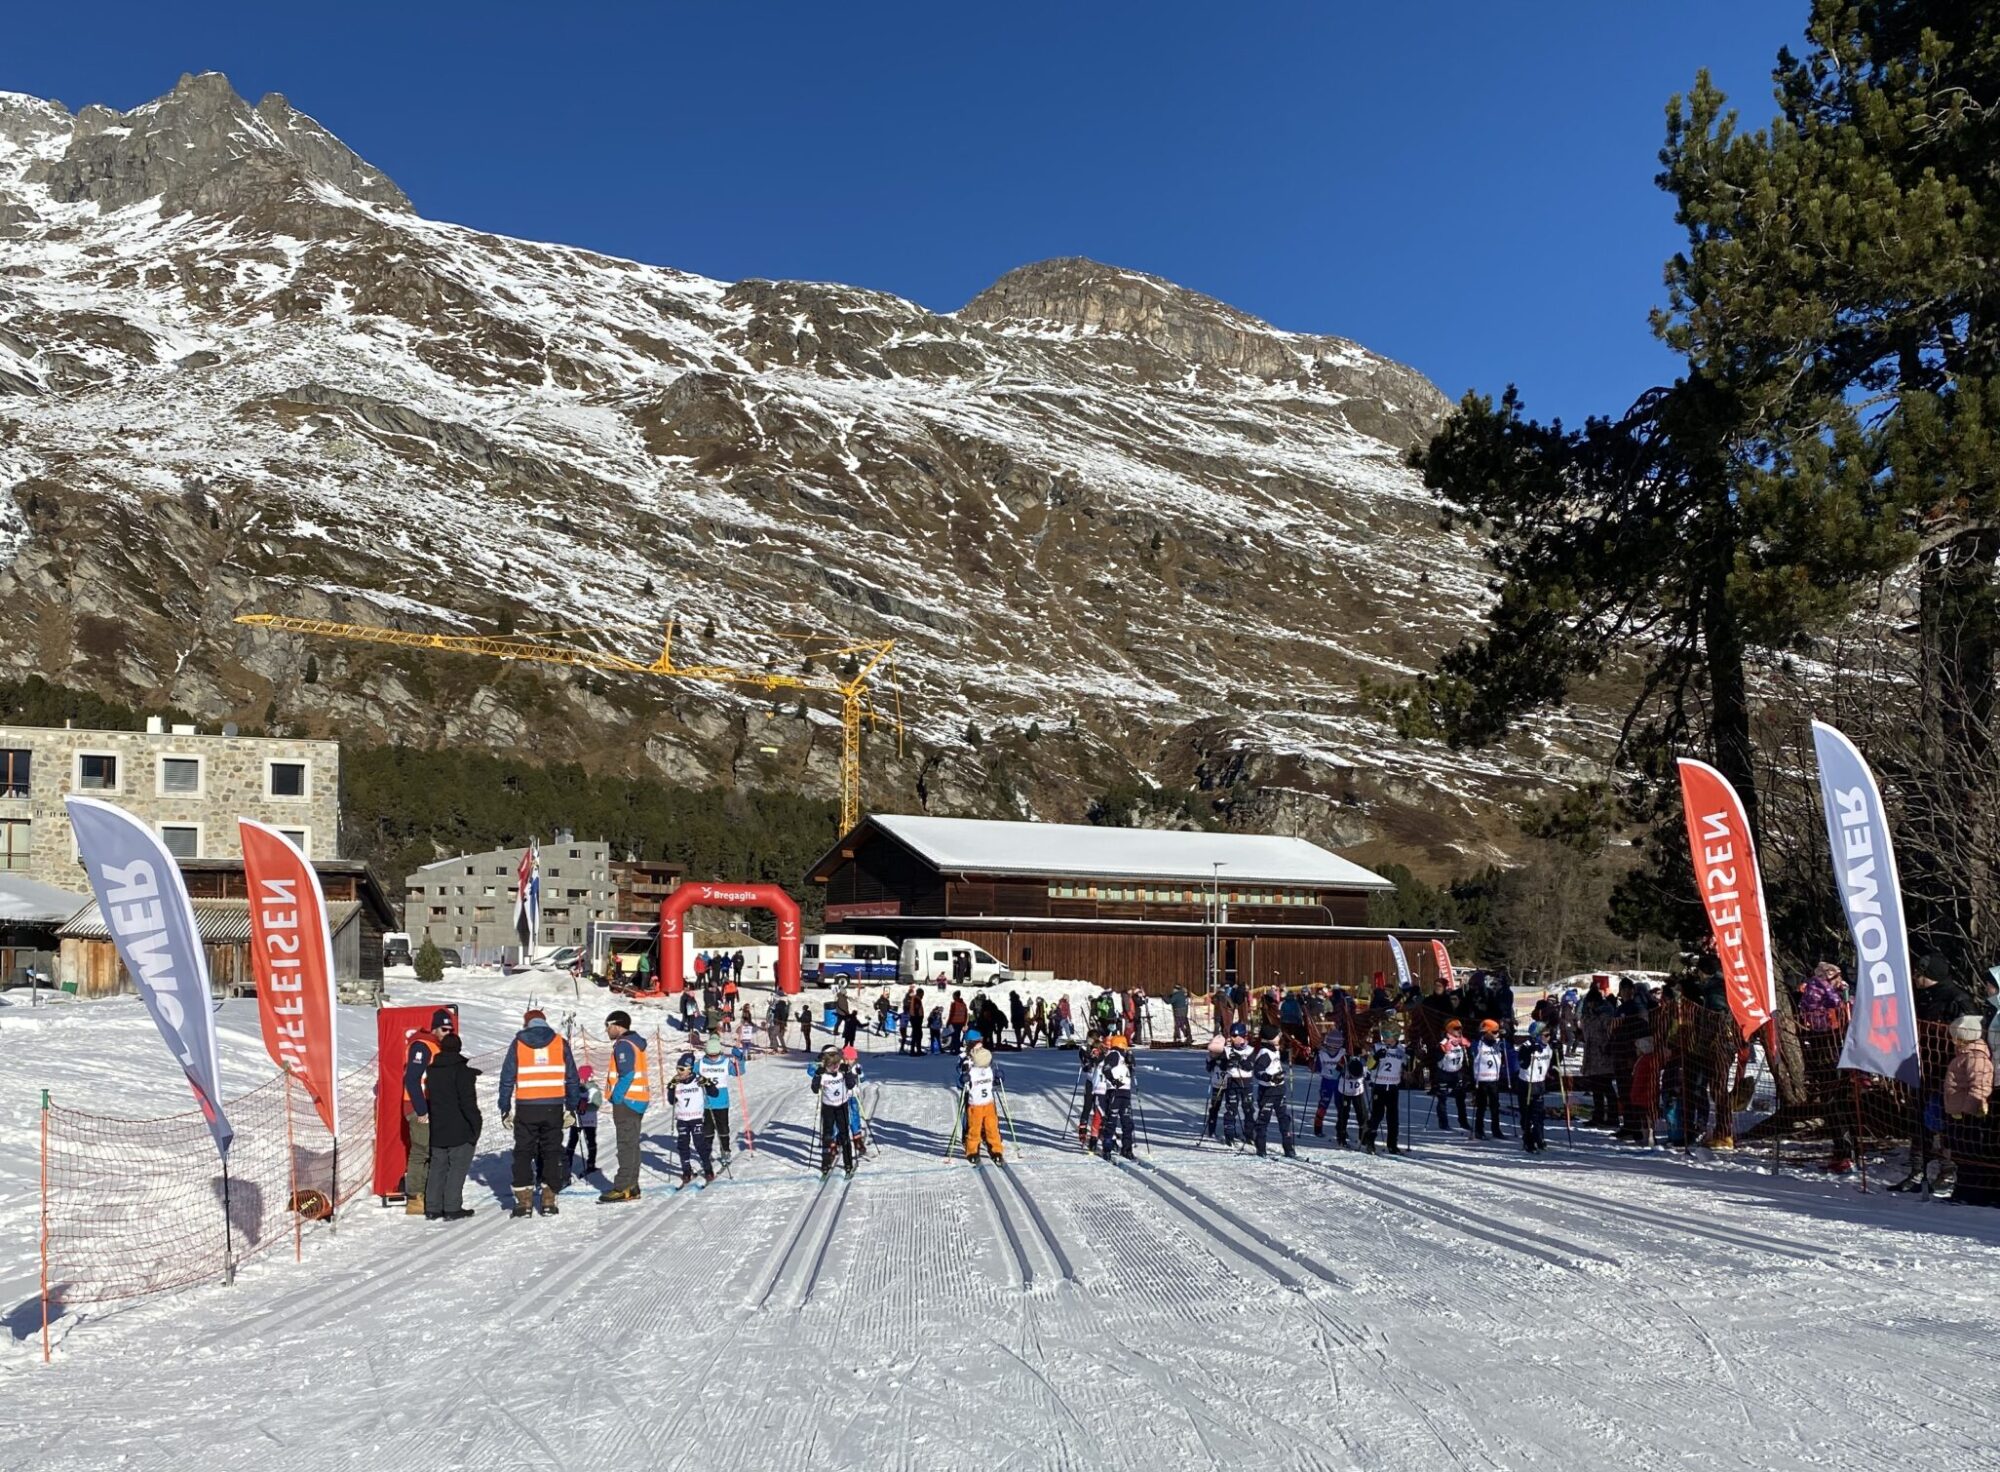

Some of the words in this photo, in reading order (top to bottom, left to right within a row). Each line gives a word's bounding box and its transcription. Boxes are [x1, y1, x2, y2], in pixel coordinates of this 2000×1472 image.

[714, 891, 757, 902] Bregaglia
[1384, 1062, 1393, 1072] 2
[1487, 1060, 1494, 1069] 9
[1538, 1066, 1543, 1075] 1
[833, 1089, 840, 1097] 6
[981, 1089, 988, 1098] 5
[684, 1098, 691, 1108] 7
